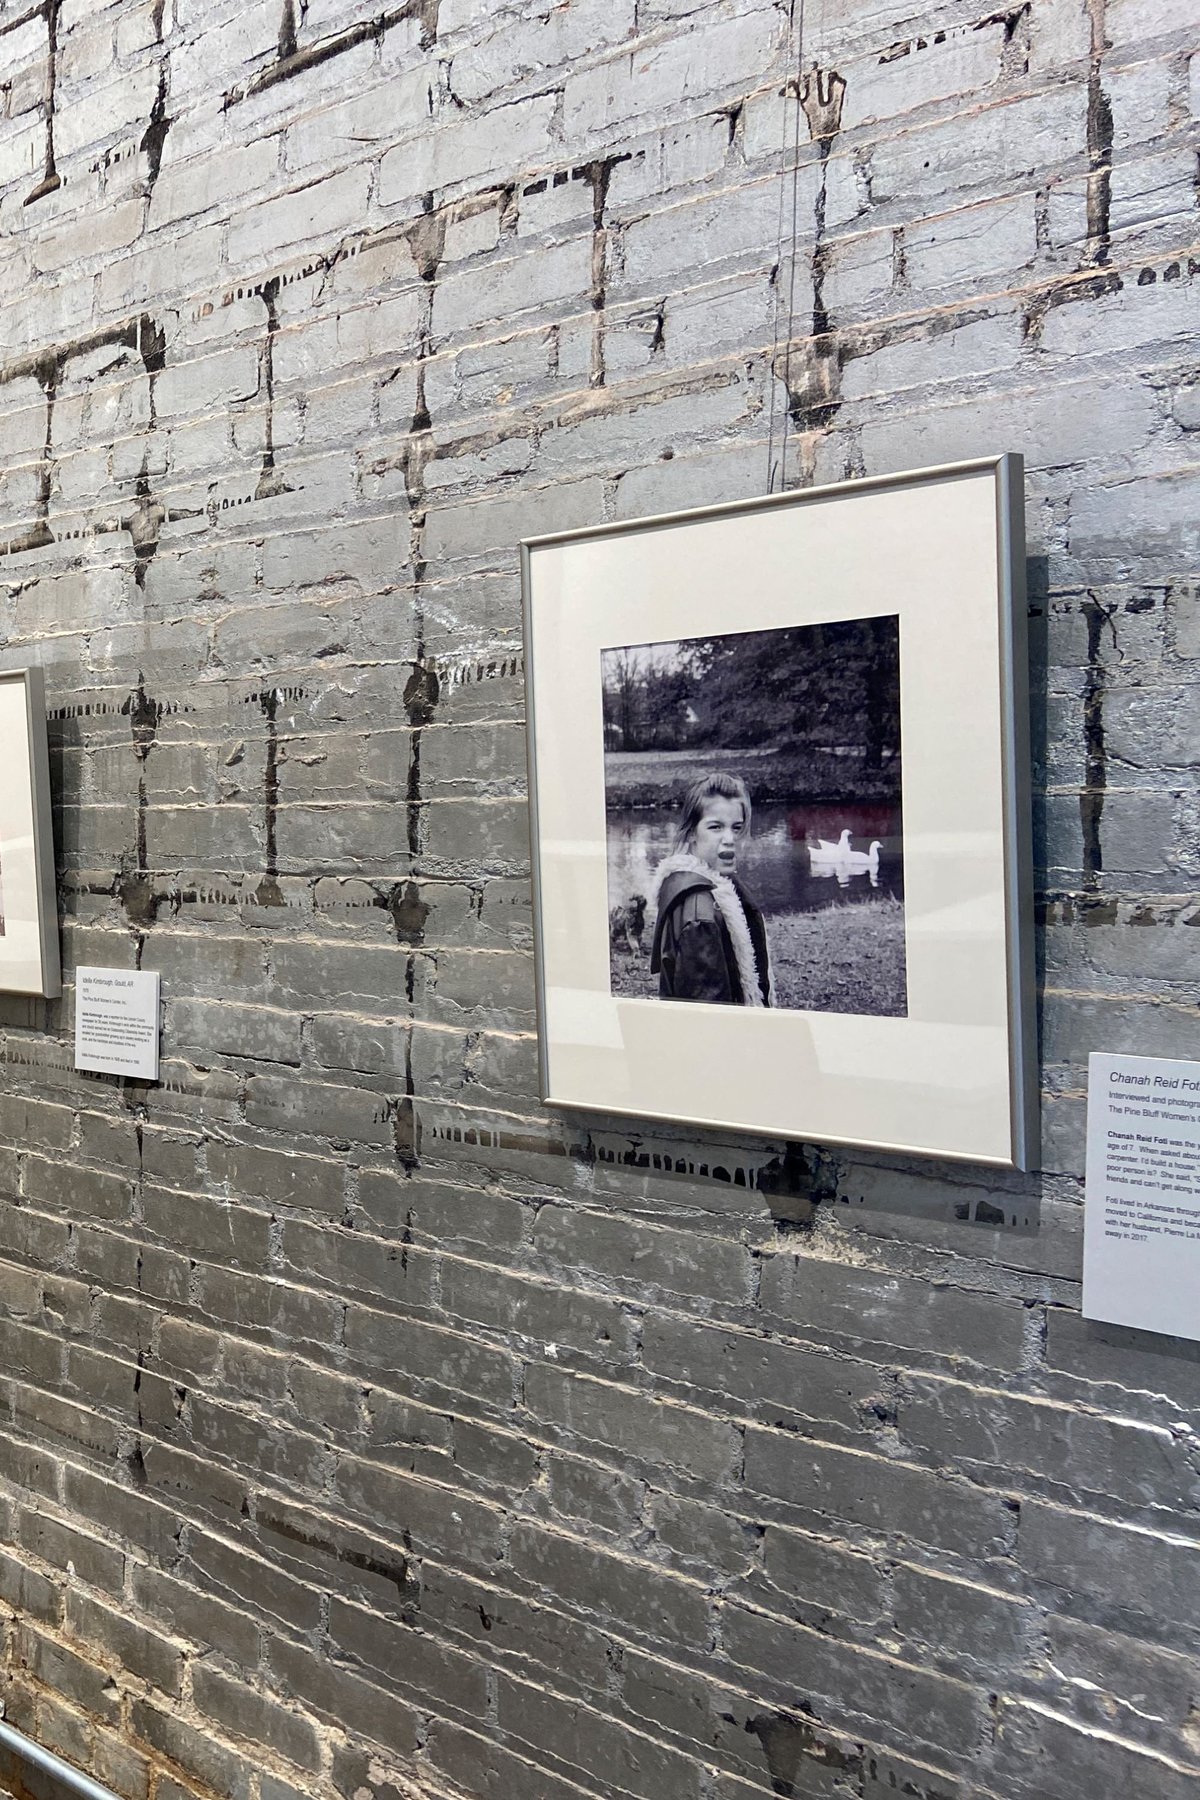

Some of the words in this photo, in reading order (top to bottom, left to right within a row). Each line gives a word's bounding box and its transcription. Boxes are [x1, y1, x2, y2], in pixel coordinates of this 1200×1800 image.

[1110, 1072, 1150, 1086] Chanah
[1154, 1076, 1180, 1089] Reid
[1109, 1091, 1150, 1103] Interviewed
[1152, 1096, 1166, 1104] and
[1109, 1104, 1122, 1114] The
[1124, 1107, 1140, 1116] Pine
[1142, 1109, 1160, 1118] Bluff
[1160, 1111, 1196, 1122] Women's
[1108, 1130, 1134, 1140] Chanah
[1136, 1134, 1152, 1142] Reid
[1154, 1136, 1168, 1144] Foti
[1139, 1146, 1158, 1154] When
[1150, 1158, 1166, 1166] build
[1123, 1167, 1146, 1175] person
[1160, 1170, 1174, 1179] She
[1106, 1174, 1128, 1184] friends
[1174, 1184, 1192, 1194] along
[1106, 1196, 1118, 1204] Foti
[1120, 1198, 1135, 1206] lived
[1144, 1202, 1175, 1212] Arkansas
[1106, 1208, 1128, 1216] moved
[1137, 1212, 1168, 1223] California
[1104, 1230, 1122, 1240] away
